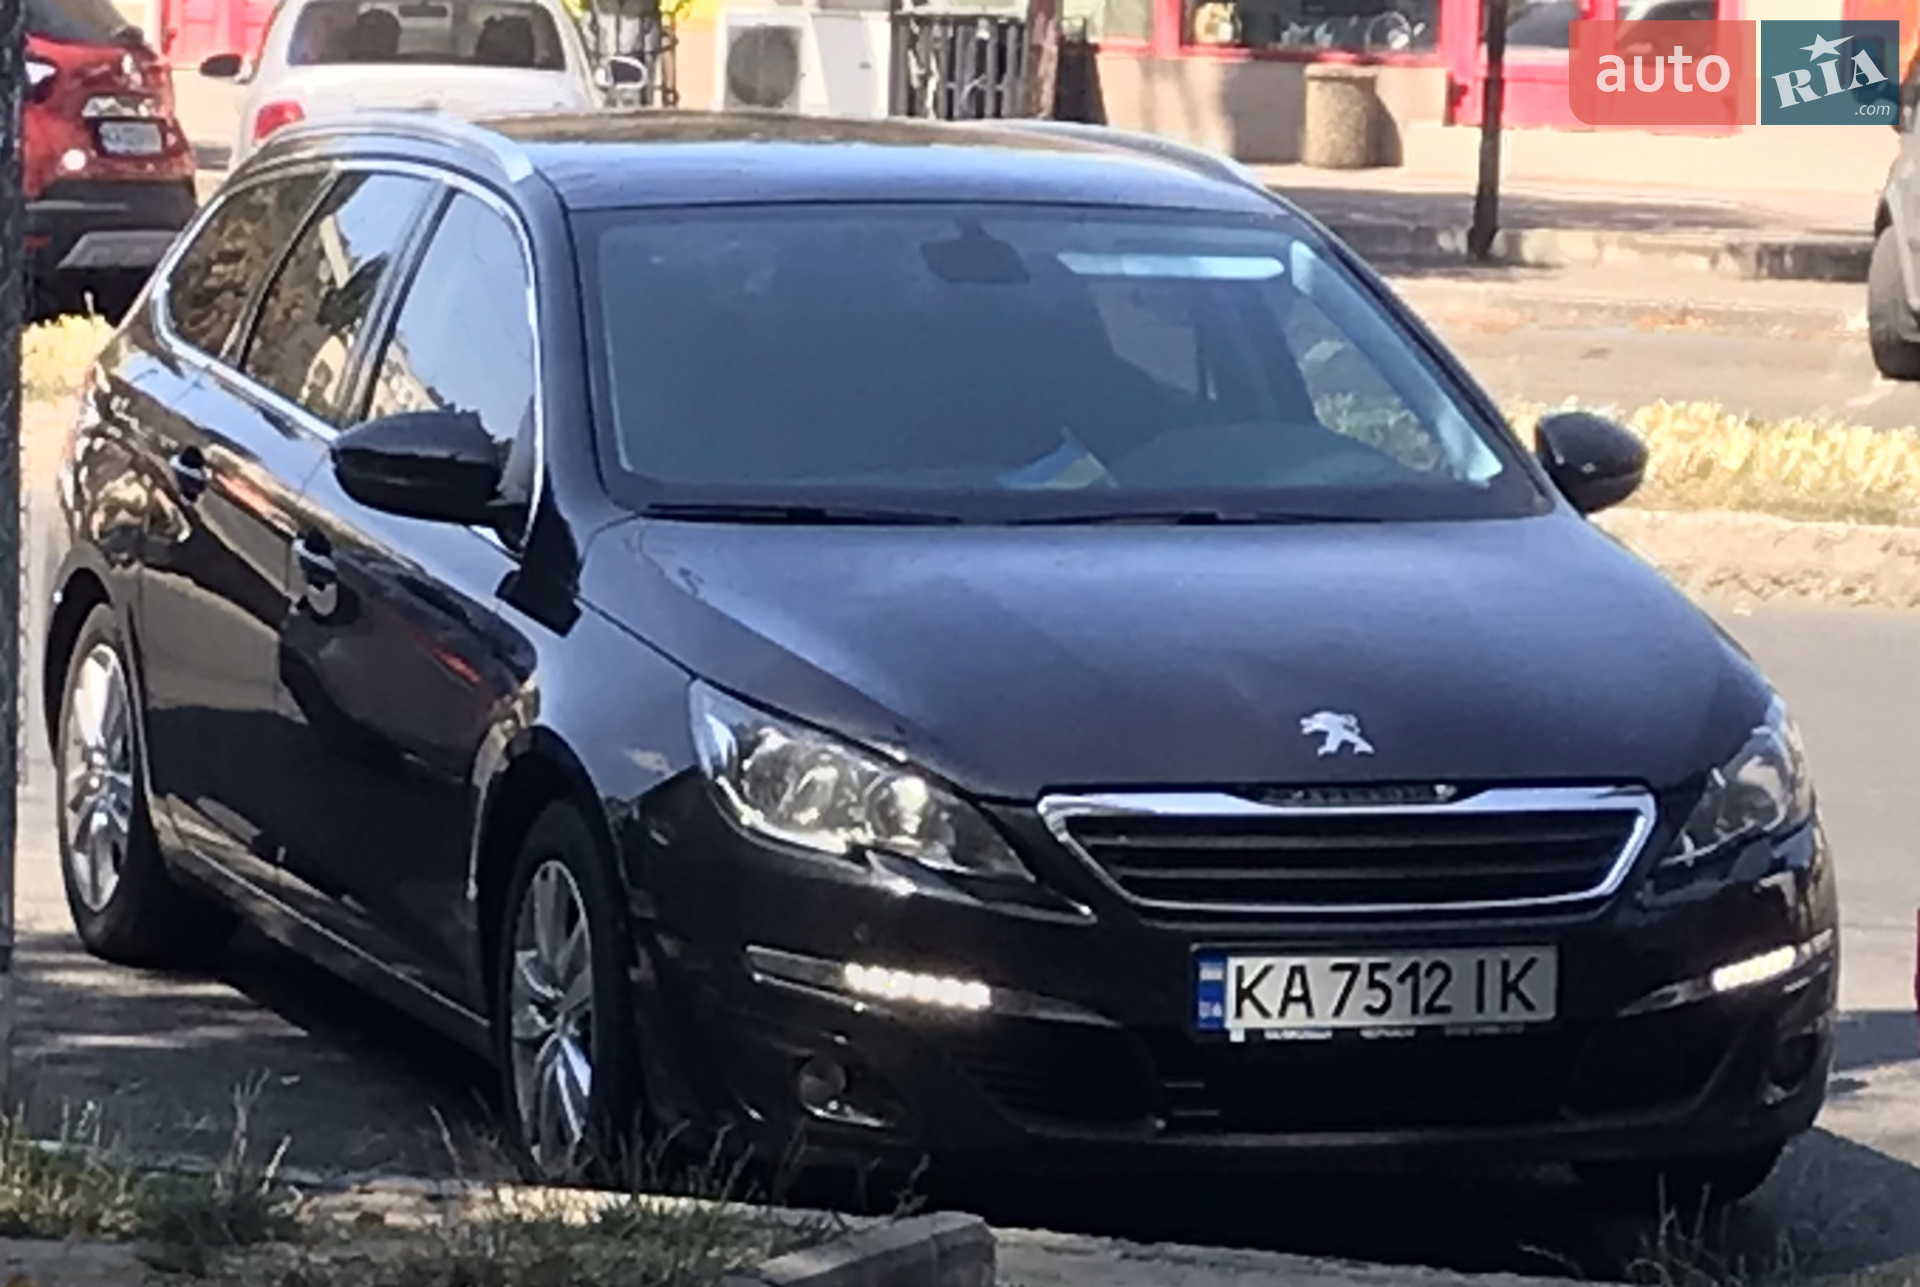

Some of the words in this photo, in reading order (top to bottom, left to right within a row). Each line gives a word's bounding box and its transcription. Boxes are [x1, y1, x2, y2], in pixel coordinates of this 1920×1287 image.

[1234, 963, 1315, 1019] KA
[1330, 960, 1453, 1017] 7512
[1475, 957, 1539, 1014] IK
